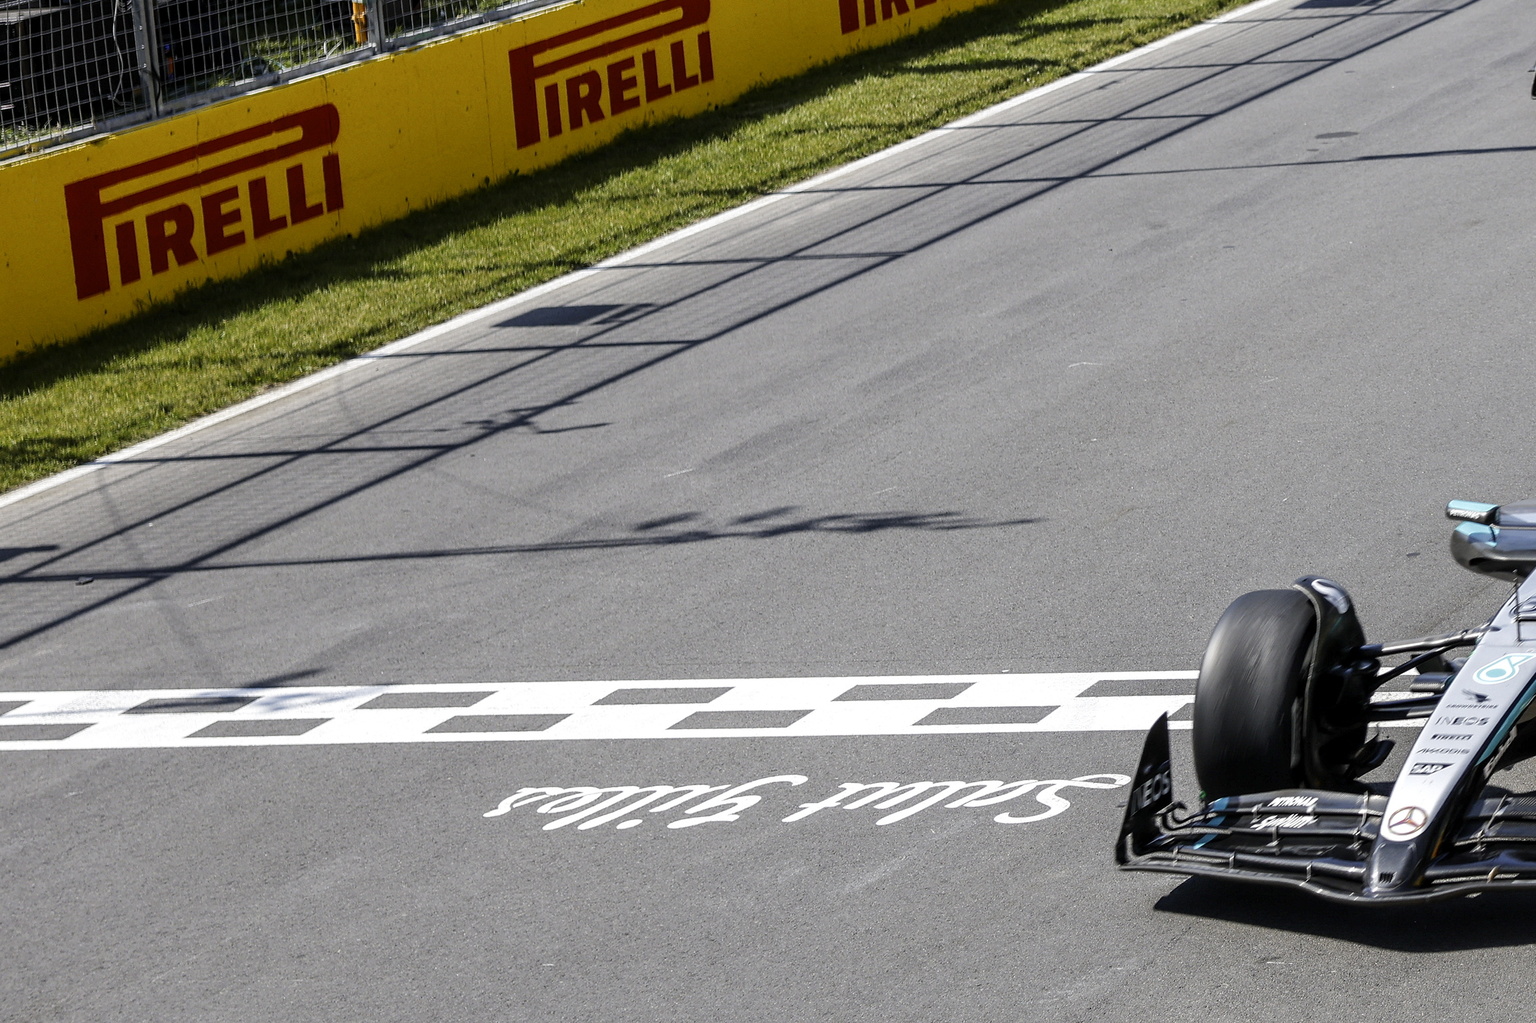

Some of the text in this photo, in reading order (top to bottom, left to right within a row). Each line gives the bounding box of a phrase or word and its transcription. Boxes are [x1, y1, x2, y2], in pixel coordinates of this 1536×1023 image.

[65, 103, 345, 301] PIRELLI
[1435, 716, 1490, 726] INEOS
[782, 774, 1132, 826] Salut
